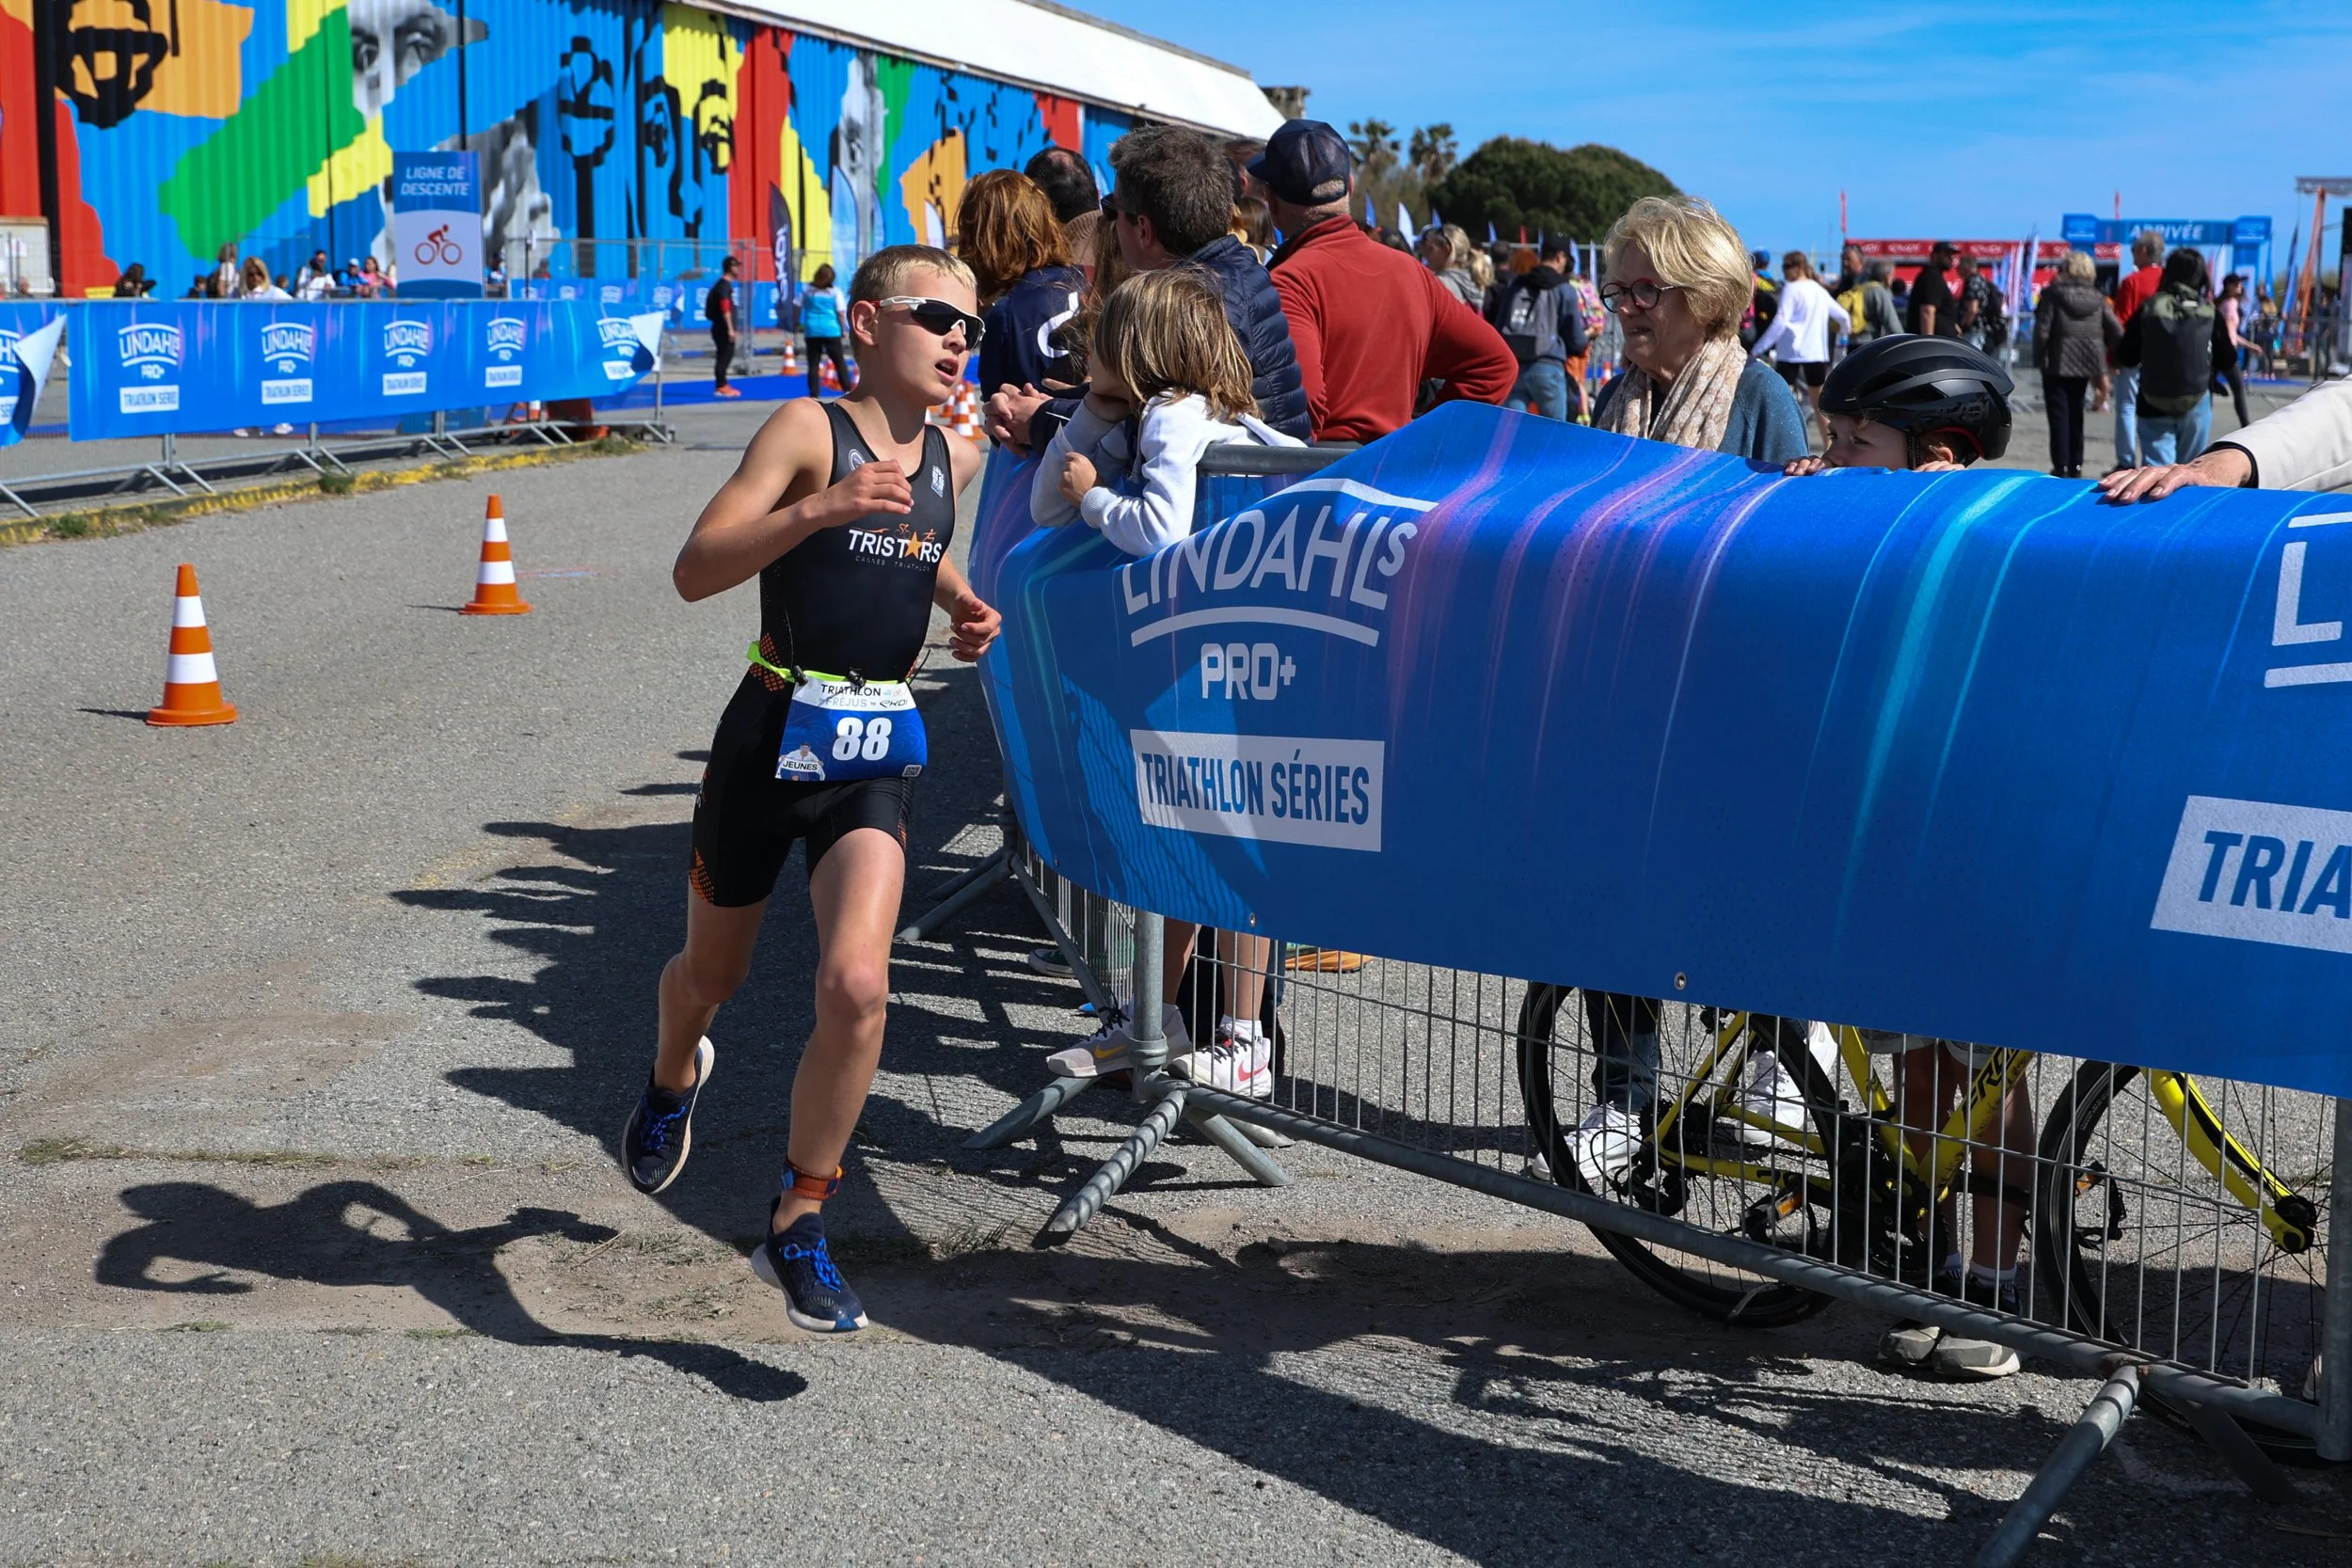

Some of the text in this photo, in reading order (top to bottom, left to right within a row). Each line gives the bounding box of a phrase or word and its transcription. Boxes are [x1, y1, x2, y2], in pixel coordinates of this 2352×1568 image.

[405, 166, 467, 180] LIGNE DE
[400, 182, 470, 196] DESCENTE
[855, 556, 885, 566] CANNES
[1122, 504, 1418, 615] LINDAHLS
[1200, 642, 1296, 701] PRO+
[820, 684, 882, 697] TRIATHLON
[832, 717, 892, 761] 88
[782, 759, 818, 771] JEUNES
[1141, 749, 1370, 825] TRIATHLON SÉRIES
